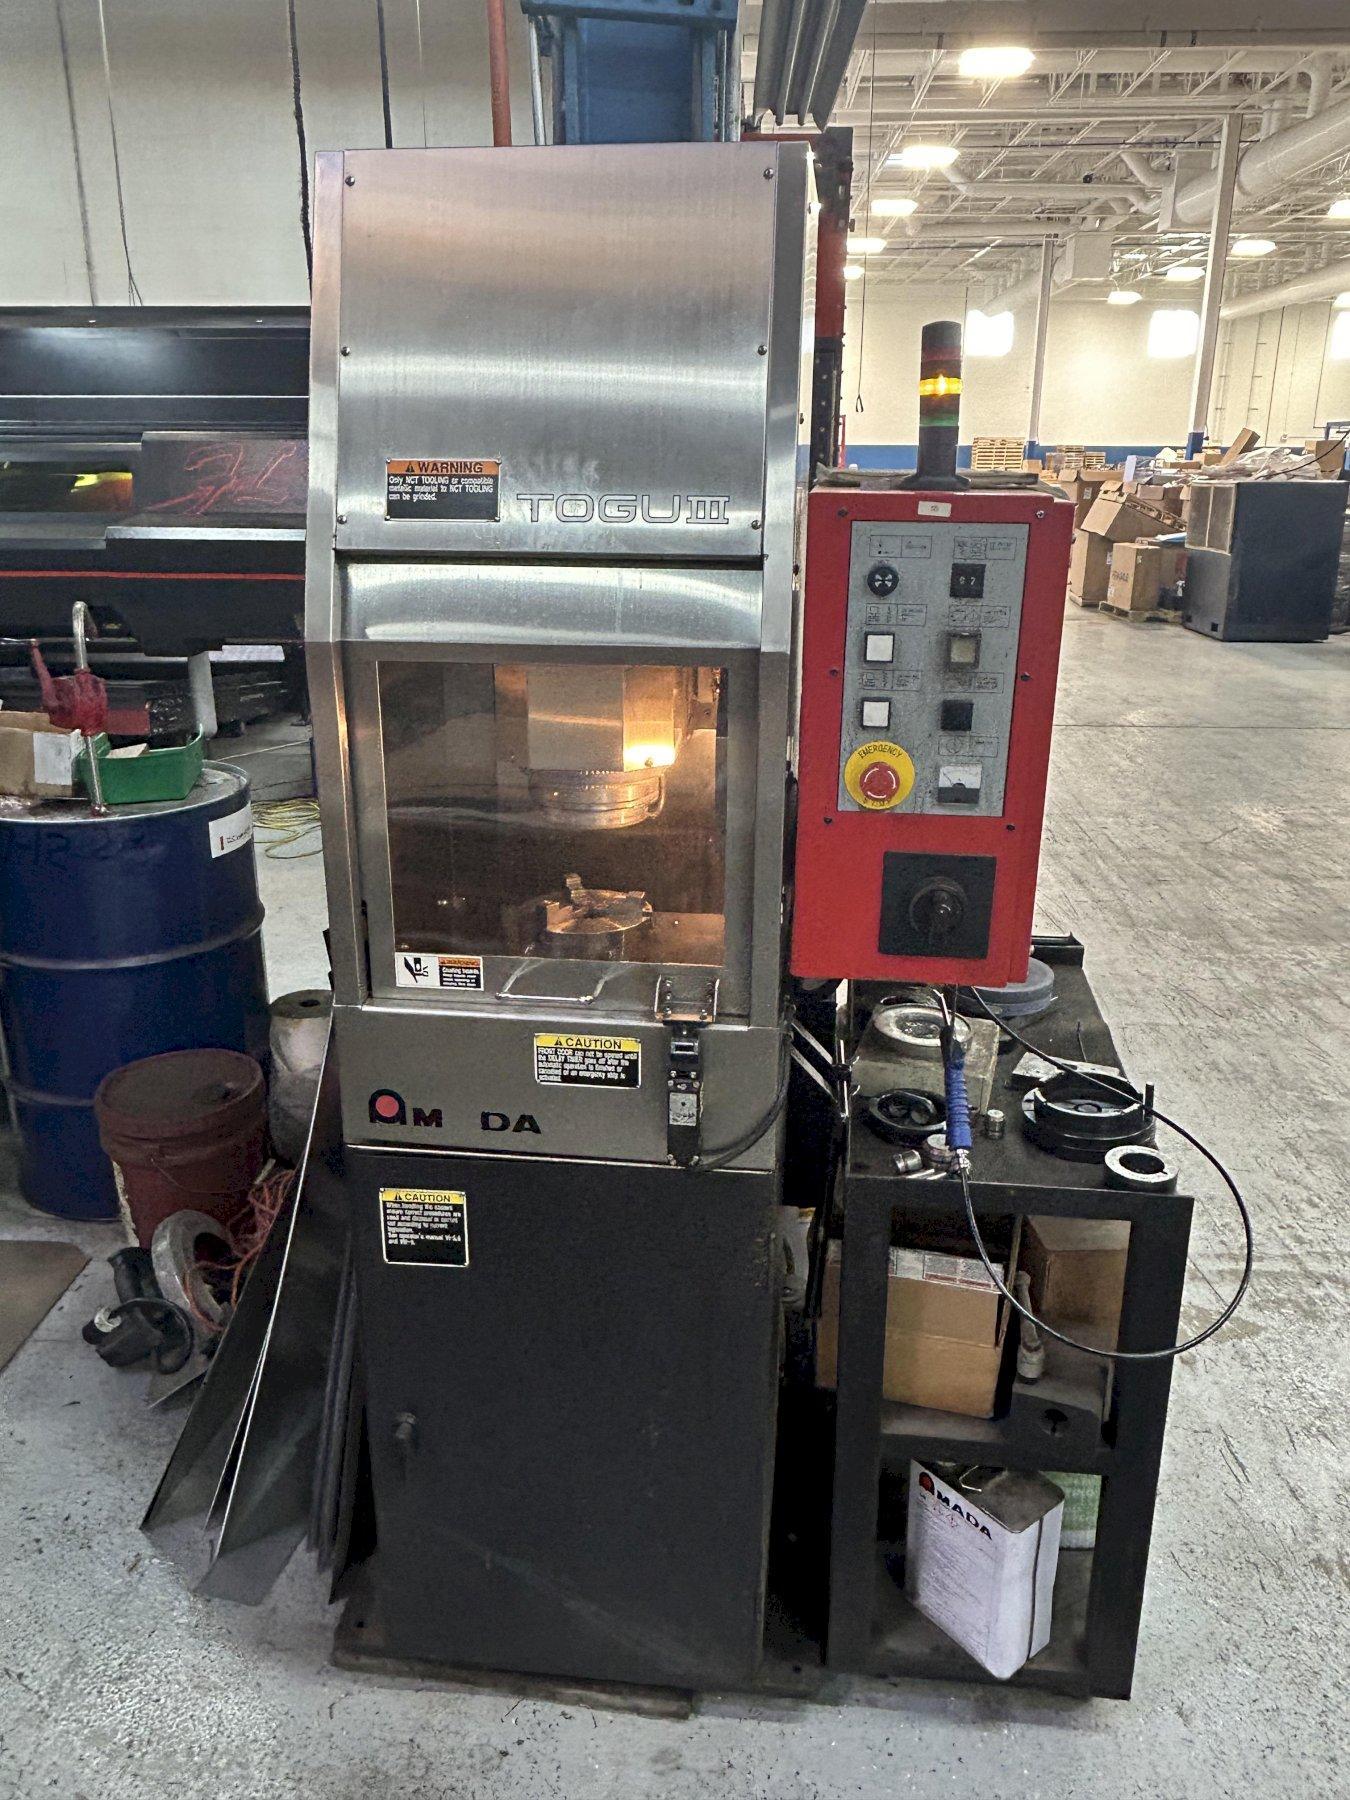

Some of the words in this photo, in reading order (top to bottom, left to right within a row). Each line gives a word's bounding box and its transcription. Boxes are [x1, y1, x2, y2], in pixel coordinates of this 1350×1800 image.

[418, 462, 483, 473] WARNING
[389, 476, 403, 485] Only
[406, 476, 418, 484] NCT
[422, 476, 449, 484] TOOLING
[465, 485, 493, 493] TOOLING
[517, 494, 680, 523] TOGU
[858, 744, 903, 759] EMERGENCY
[566, 1038, 621, 1049] CAUTION
[405, 1194, 450, 1202] CAUTION
[919, 1472, 992, 1540] AMADA
